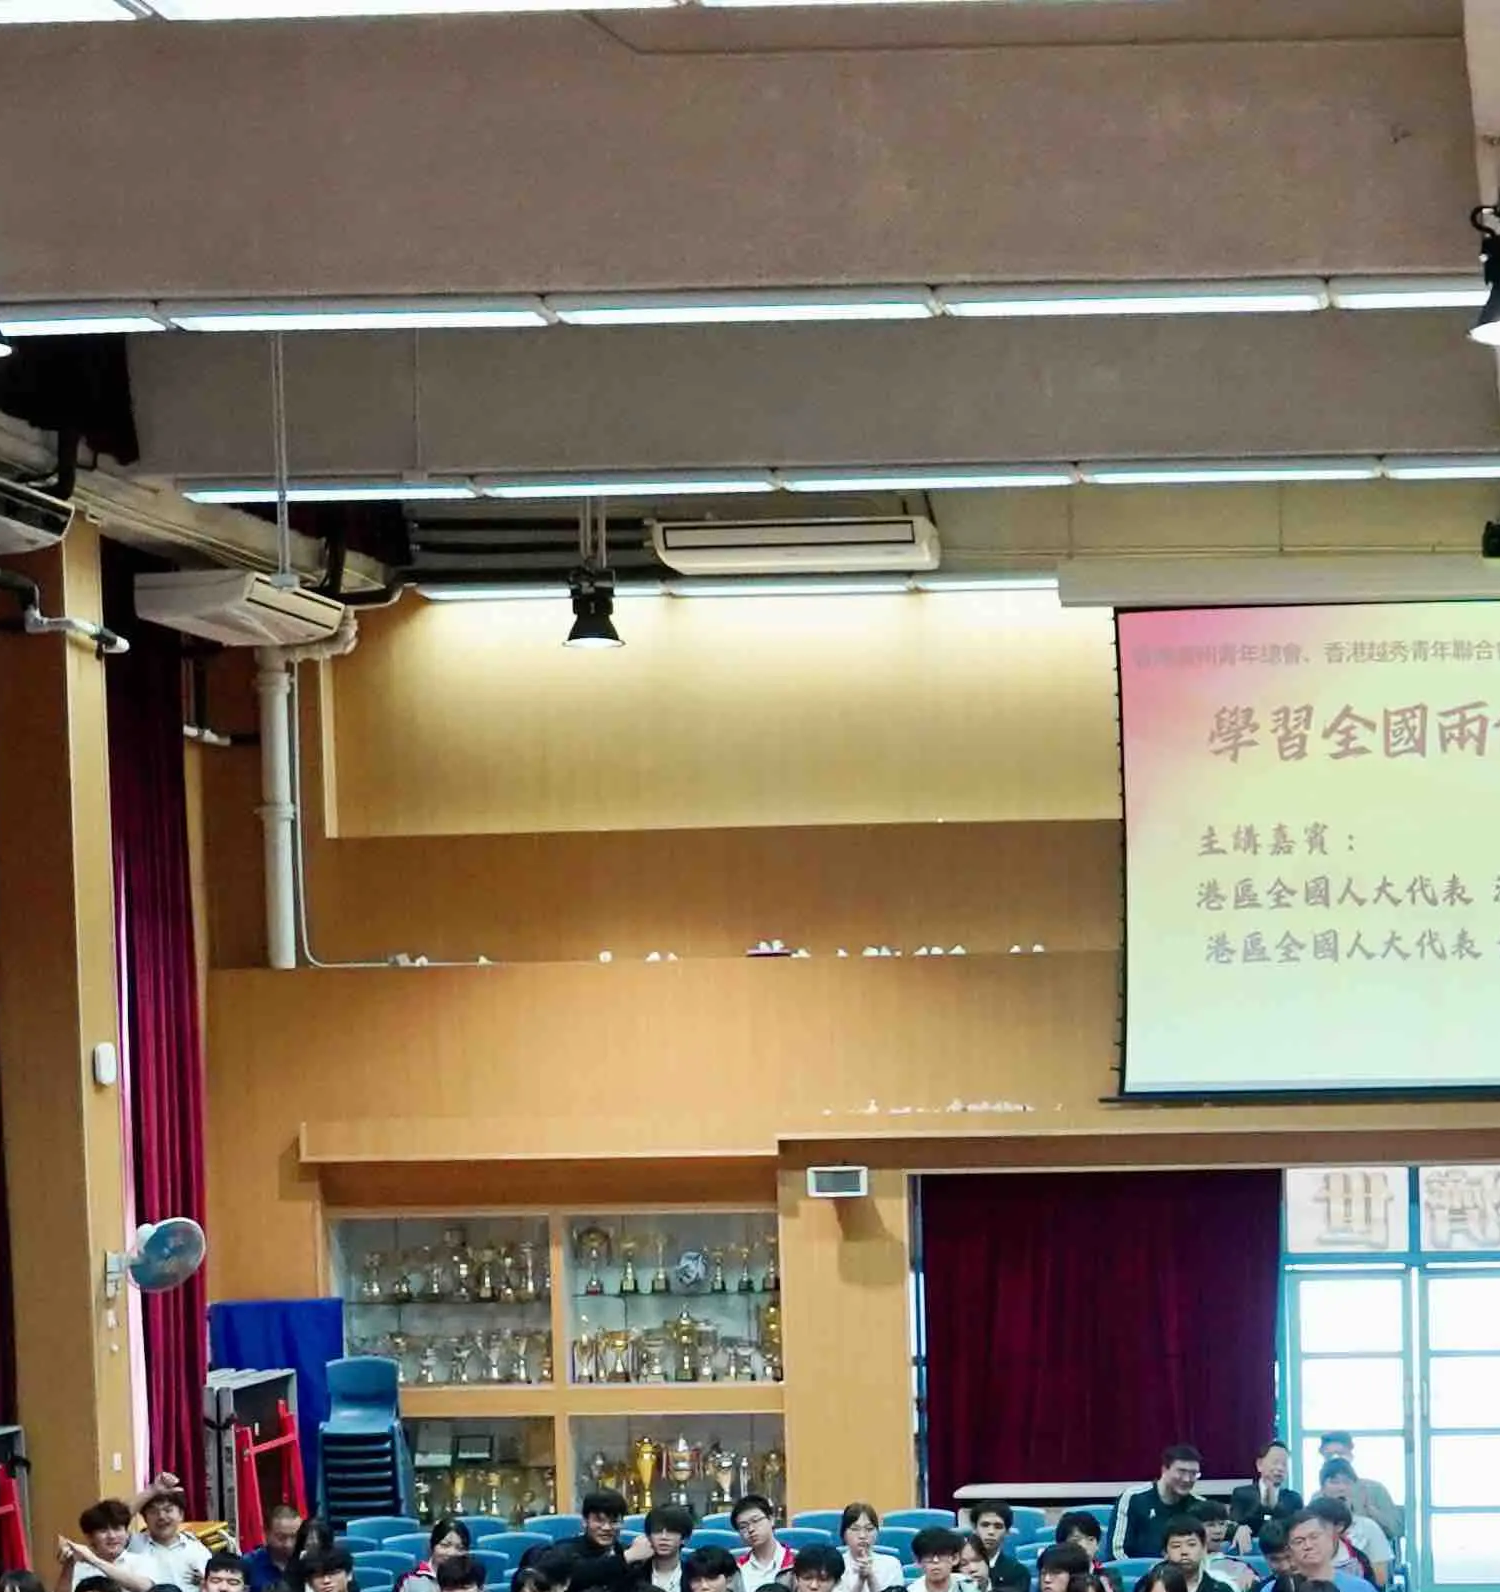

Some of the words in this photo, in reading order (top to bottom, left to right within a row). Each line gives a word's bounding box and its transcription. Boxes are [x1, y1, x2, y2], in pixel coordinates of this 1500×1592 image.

[1196, 873, 1474, 910] 港區全國人大代表
[1205, 928, 1482, 964] 港區全國人大代表
